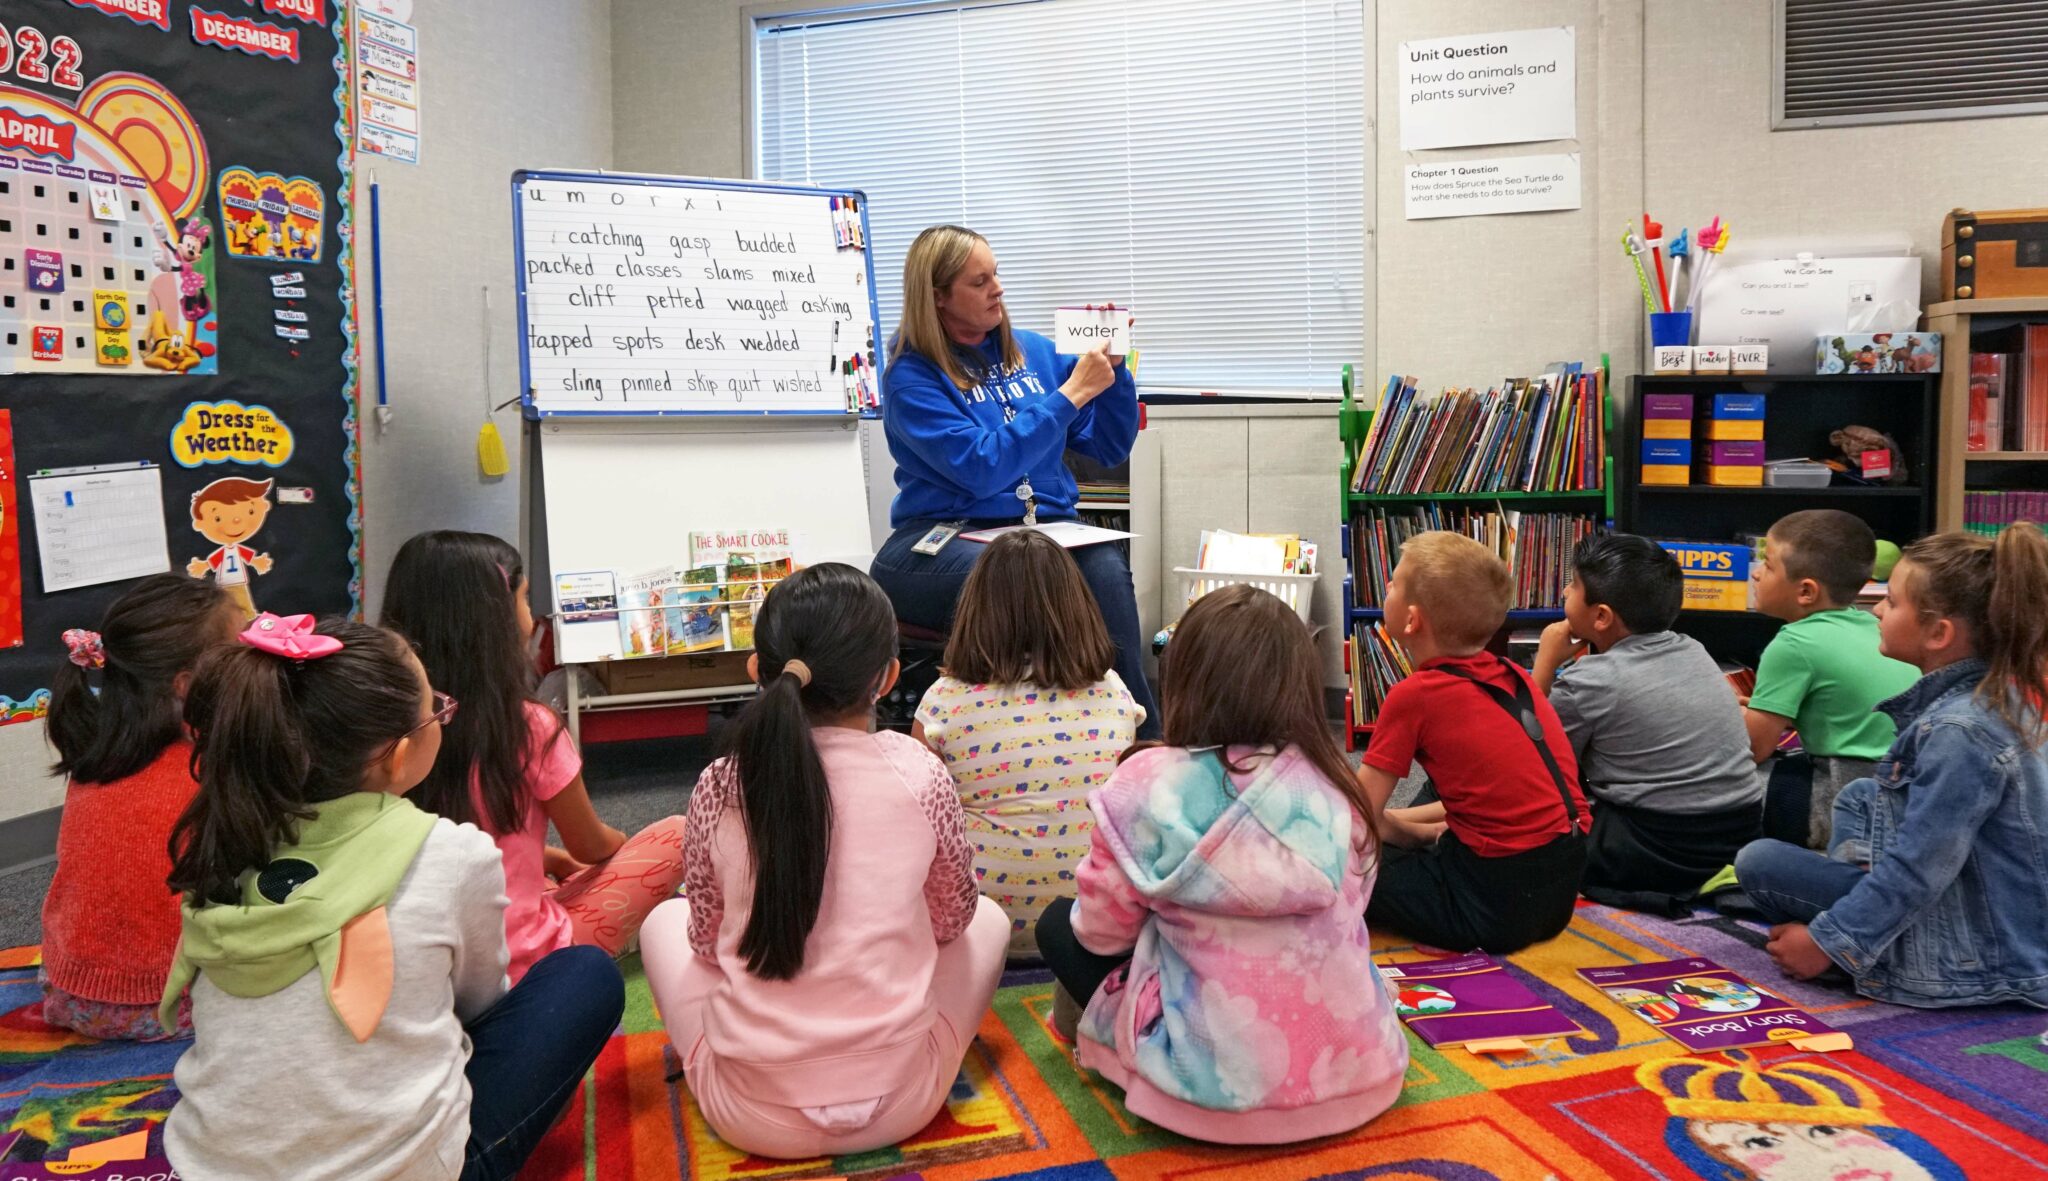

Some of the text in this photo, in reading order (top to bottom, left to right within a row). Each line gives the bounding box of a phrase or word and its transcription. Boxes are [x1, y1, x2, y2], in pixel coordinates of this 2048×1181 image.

[202, 18, 291, 54] DECEMBER
[1410, 43, 1508, 62] Unit Question
[1411, 60, 1556, 85] How do animals and
[1411, 82, 1515, 105] plants survive?
[93, 171, 112, 183] Friday
[1411, 165, 1499, 180] Chapter 1 Question
[1411, 173, 1564, 192] How does Spruce the Sea Turtle do
[227, 196, 257, 209] THURSDAY
[530, 189, 722, 211] u m o r x i
[1411, 185, 1552, 203] what she needs to do to survive?
[261, 201, 285, 213] FRIDAY
[292, 204, 320, 219] SATURDAY
[568, 223, 796, 258] catching gasp budded
[30, 260, 61, 270] Dismissal
[36, 253, 53, 263] Early
[528, 253, 816, 285] packed classes slams mixed
[1784, 266, 1833, 276] We Can See
[1742, 282, 1757, 290] Can
[1758, 282, 1772, 291] you
[95, 292, 127, 302] Earth Day
[568, 284, 853, 322] cliff petted wagged asking
[1740, 307, 1756, 316] Can
[38, 327, 59, 336] Happy
[107, 336, 120, 344] Day
[1068, 325, 1119, 339] water
[528, 324, 800, 358] tapped spots desk wedded
[33, 350, 64, 360] Birthday
[1661, 350, 1686, 367] Best
[1696, 351, 1729, 366] Teacher
[562, 368, 822, 403] sling pinned skip quit wished
[198, 410, 270, 429] Dress for
[262, 425, 276, 433] the
[185, 431, 279, 455] Weather
[695, 532, 790, 549] THE SMART COOKIE
[226, 555, 238, 573] 1
[649, 576, 673, 589] jones
[1682, 1013, 1808, 1038] Story Book
